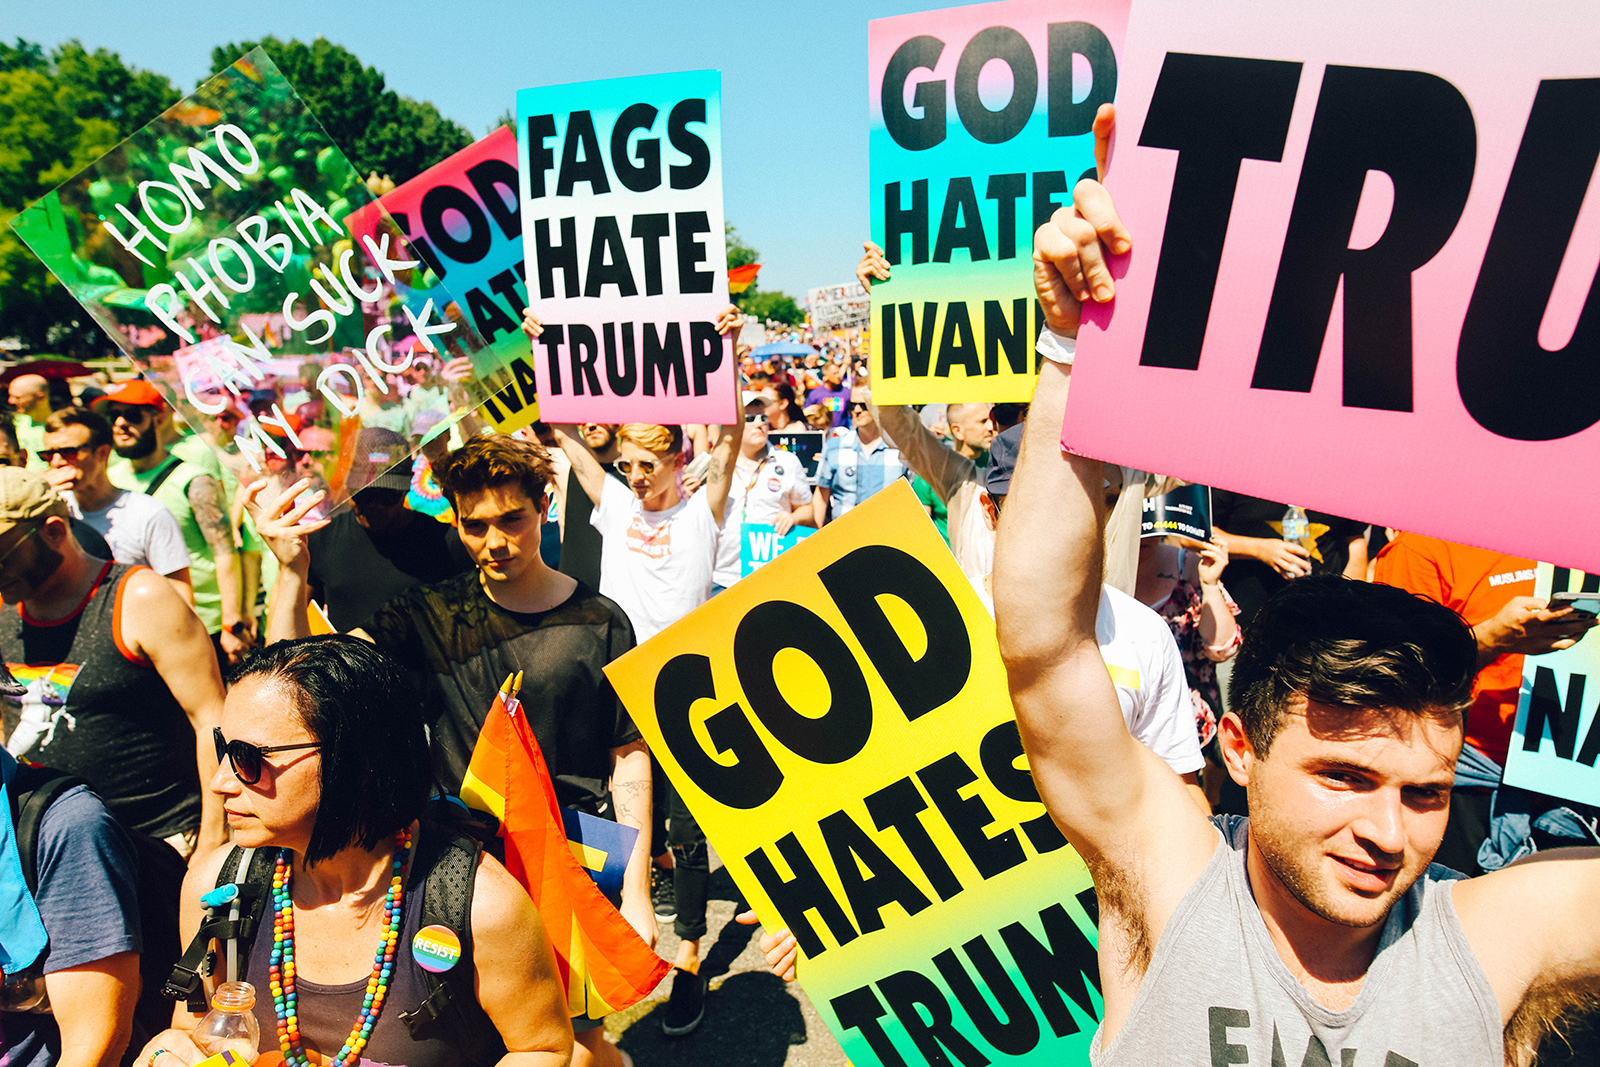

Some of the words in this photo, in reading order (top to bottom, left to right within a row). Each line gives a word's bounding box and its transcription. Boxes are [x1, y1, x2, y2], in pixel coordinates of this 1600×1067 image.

[527, 98, 711, 199] FAGS
[881, 20, 1118, 152] GOD
[103, 124, 260, 267] HOMO
[534, 210, 715, 299] HATE
[884, 167, 1100, 266] HATE
[1137, 51, 1600, 442] TRU
[144, 187, 344, 345] PHOBIA
[184, 322, 276, 415] CAN
[283, 233, 421, 346] SUCK
[233, 403, 303, 473] MY
[316, 297, 457, 417] DICK
[538, 321, 723, 398] TRUMP
[881, 297, 1040, 380] IVAN
[1488, 568, 1535, 587] MUSLIMS
[654, 545, 972, 809] GOD
[744, 720, 1071, 961] HATES
[414, 937, 458, 960] RESIST
